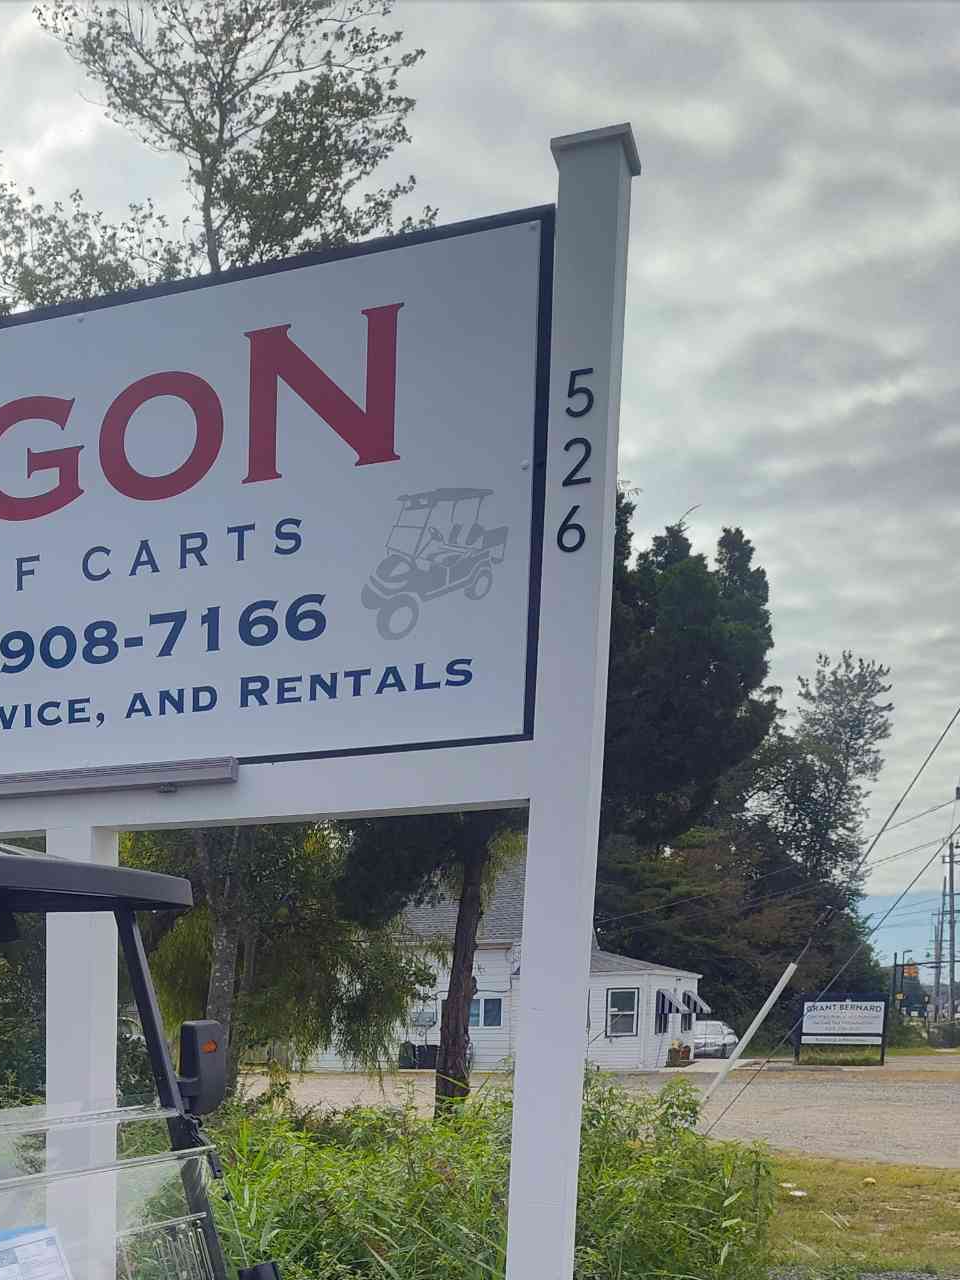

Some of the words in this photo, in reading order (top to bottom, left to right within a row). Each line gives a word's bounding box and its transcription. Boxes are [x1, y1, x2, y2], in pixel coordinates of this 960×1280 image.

[556, 367, 595, 553] 526
[81, 517, 303, 582] CARTS
[125, 685, 218, 720] AND
[240, 657, 474, 709] RENTALS
[806, 1004, 837, 1013] GRANT
[839, 1004, 882, 1013] BERNARD
